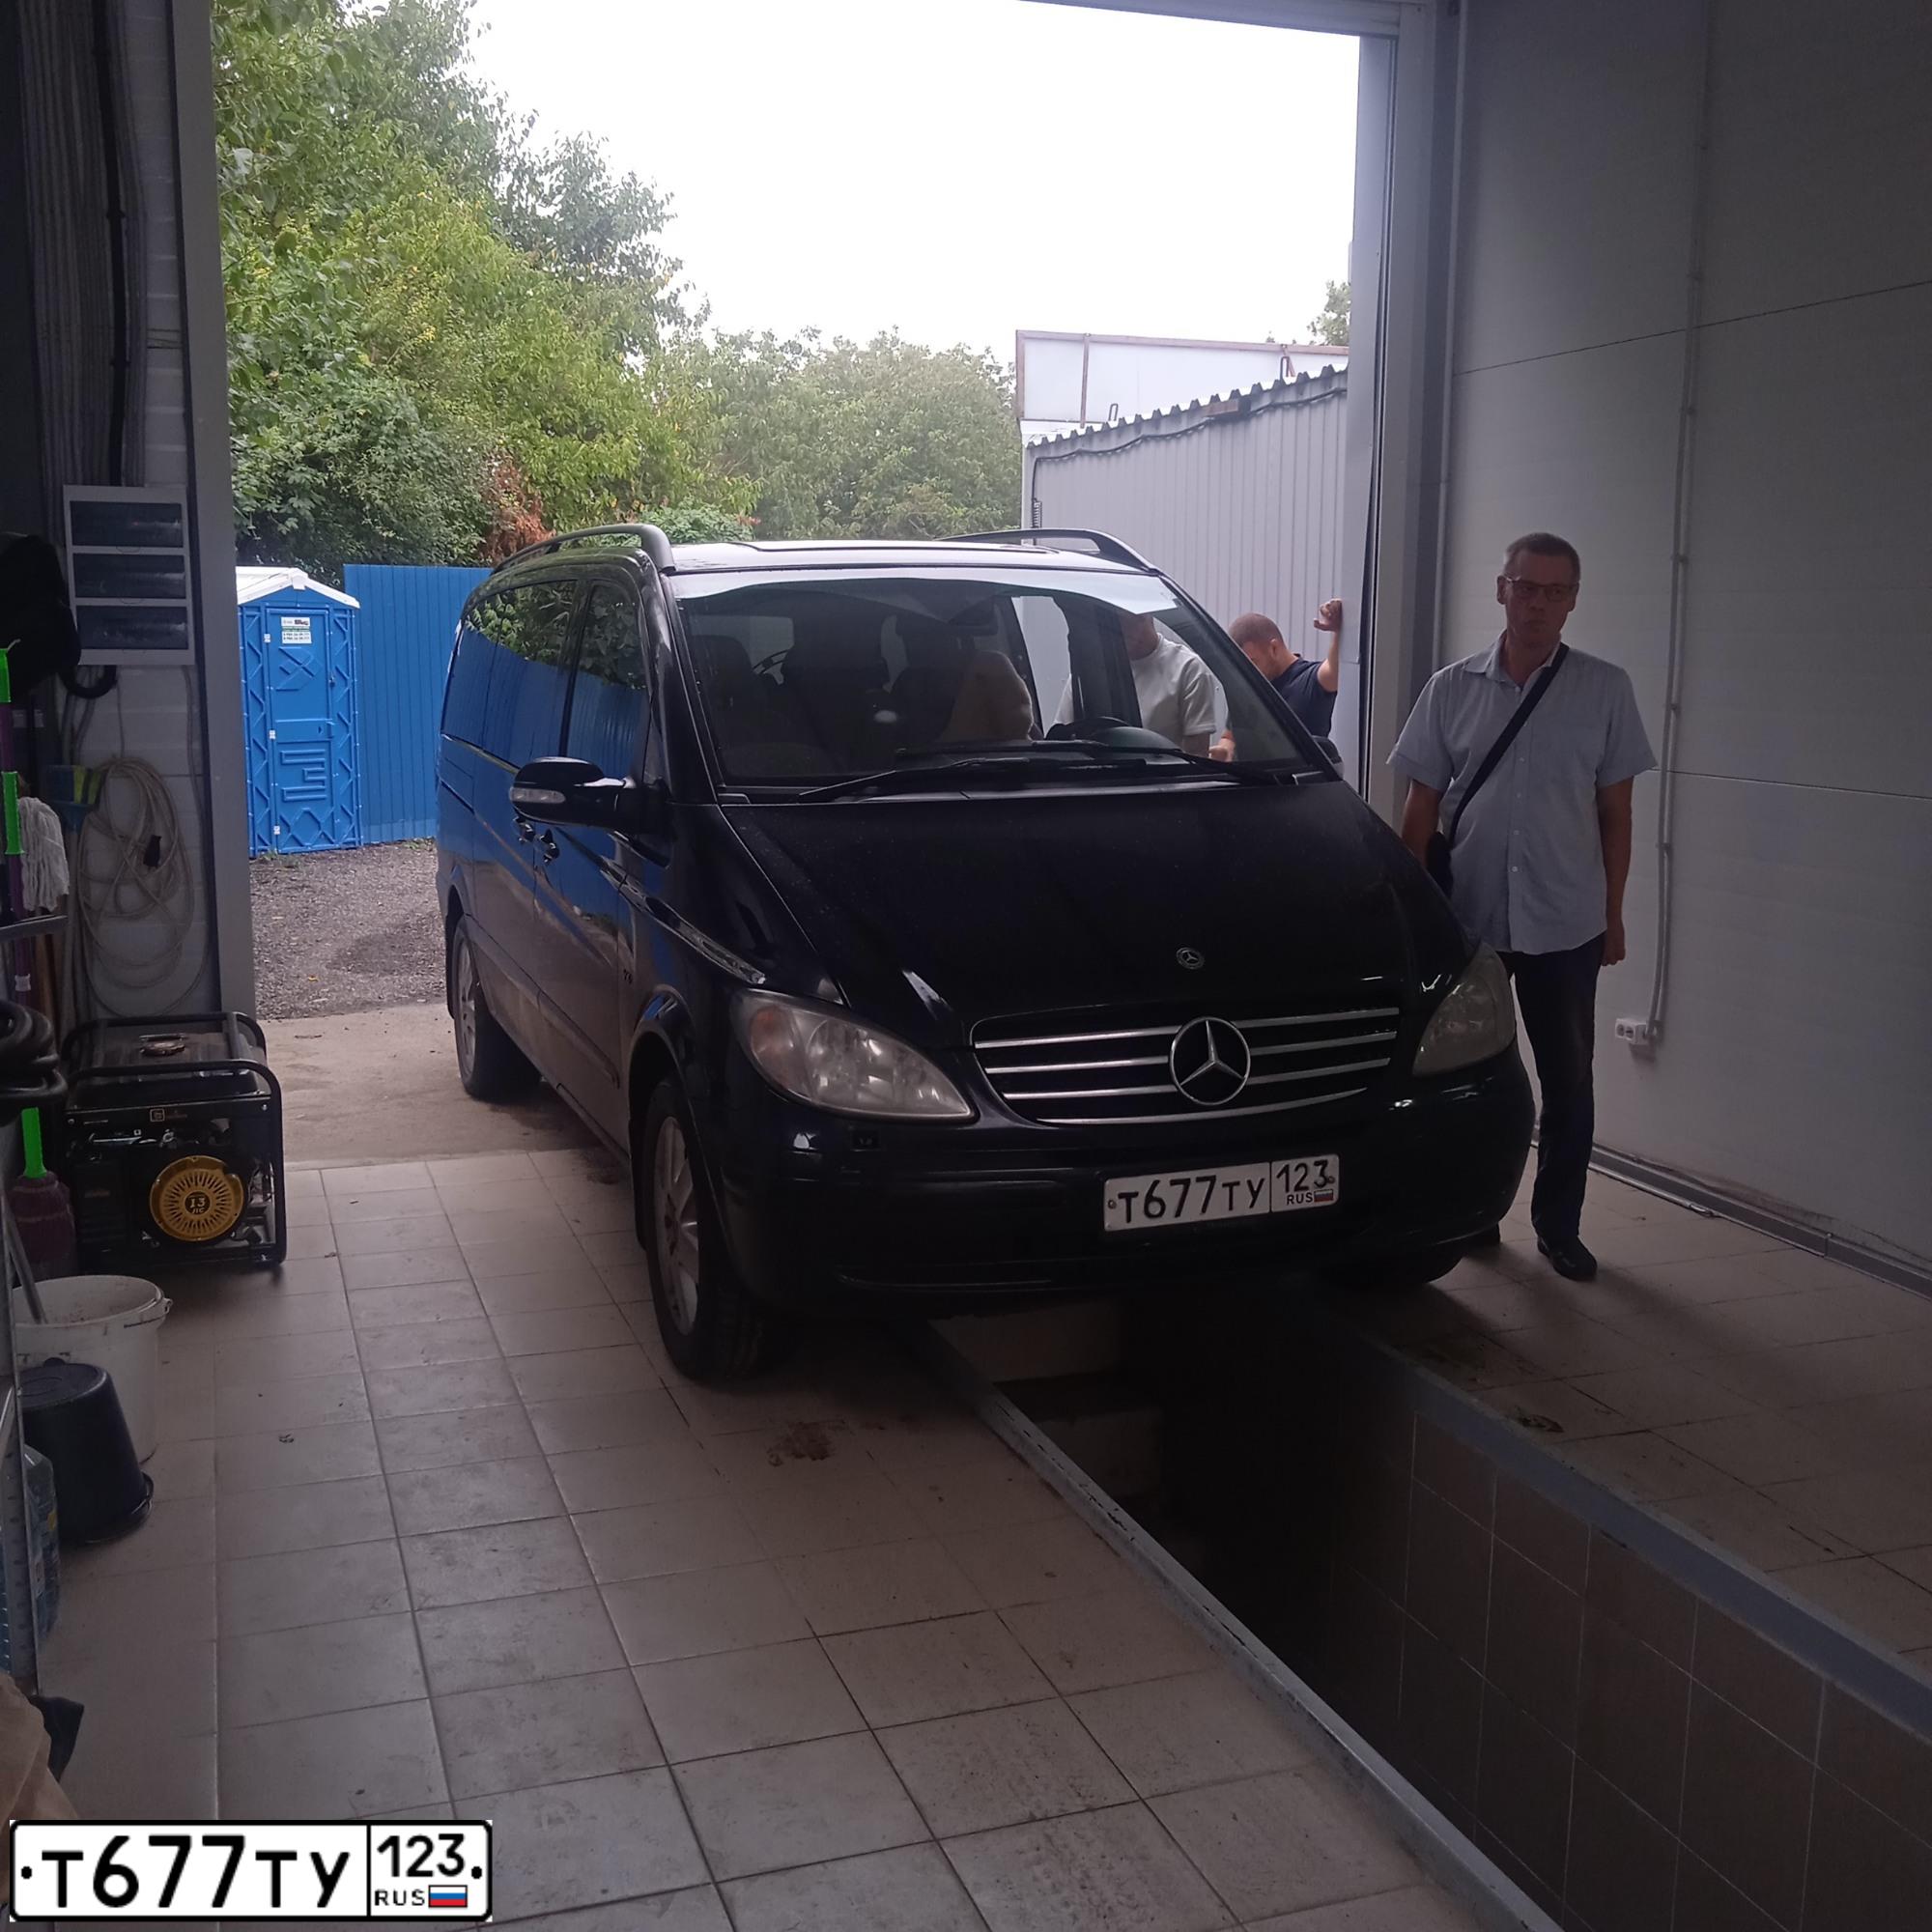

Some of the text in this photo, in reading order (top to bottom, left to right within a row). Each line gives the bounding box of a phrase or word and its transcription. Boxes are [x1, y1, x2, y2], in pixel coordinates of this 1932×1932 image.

[1118, 1159, 1329, 1223] Т677ТУ 123
[1286, 1192, 1313, 1206] RUS
